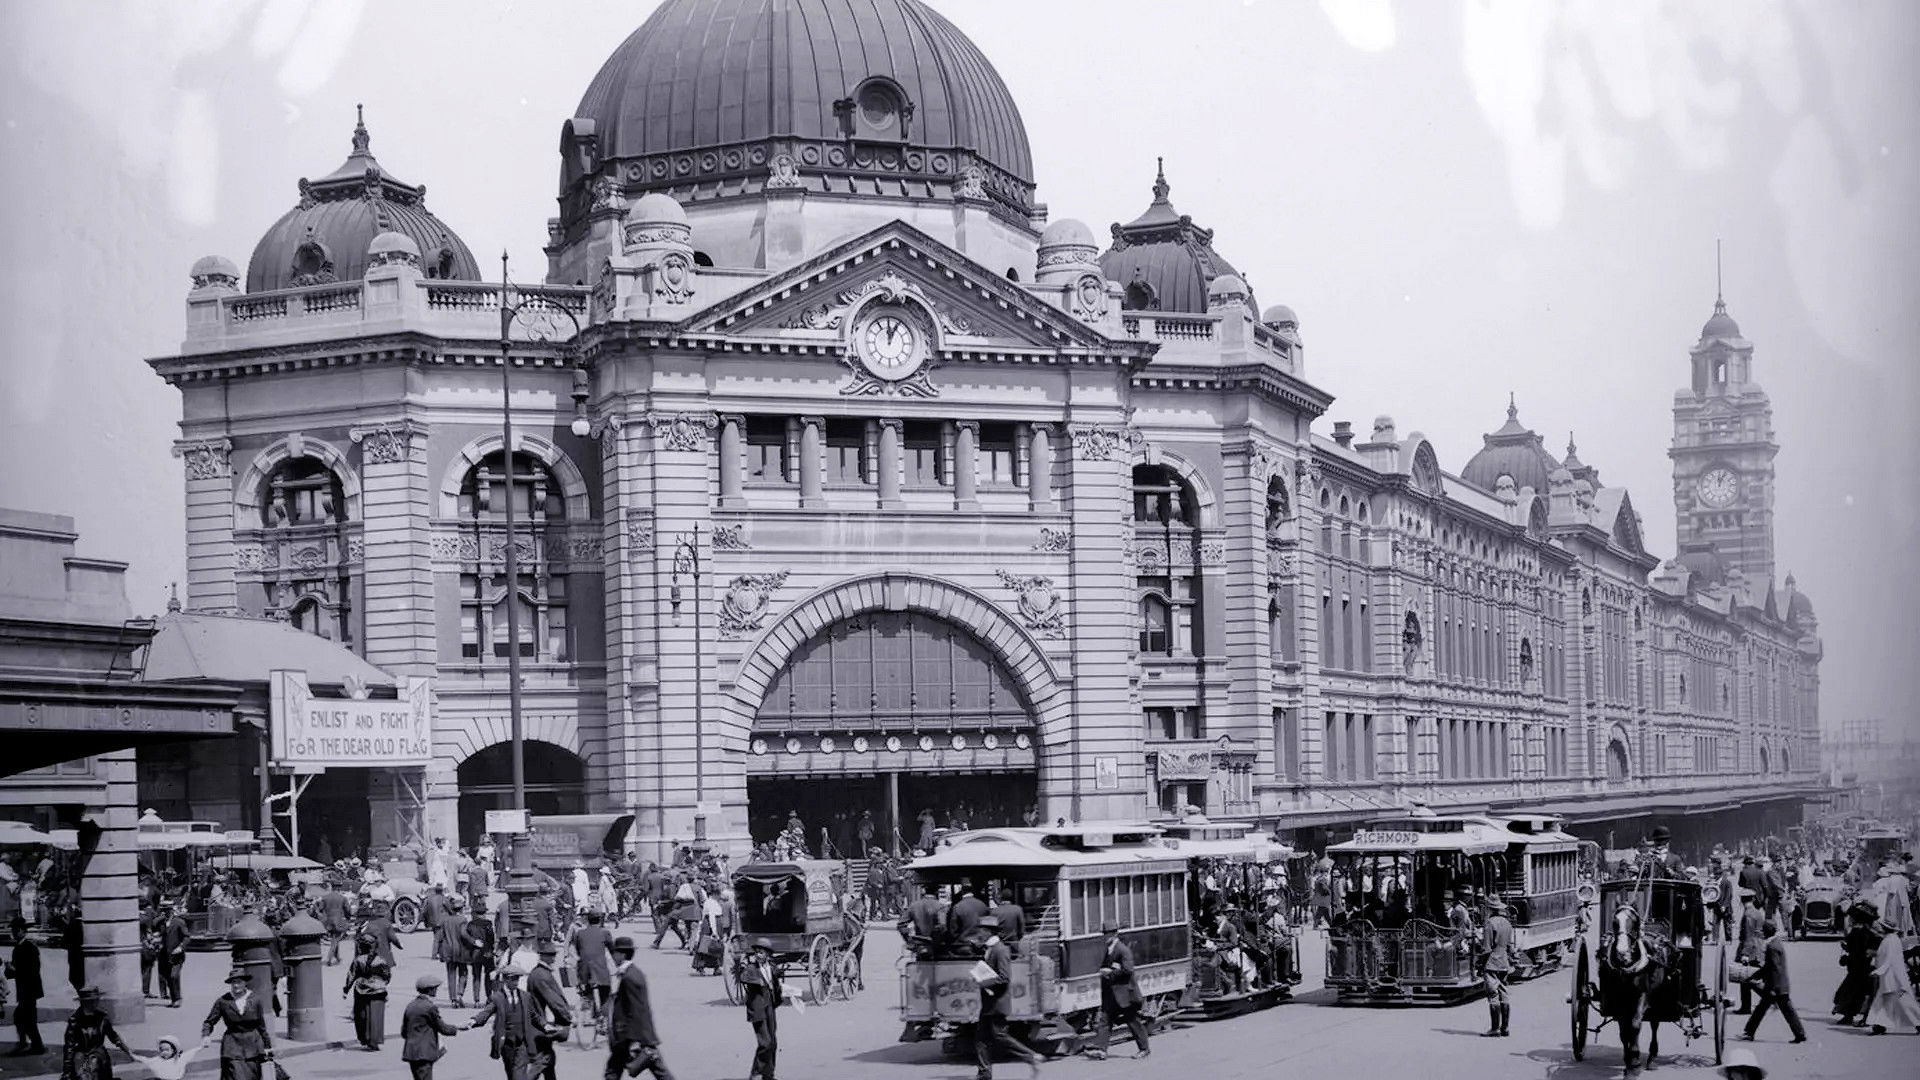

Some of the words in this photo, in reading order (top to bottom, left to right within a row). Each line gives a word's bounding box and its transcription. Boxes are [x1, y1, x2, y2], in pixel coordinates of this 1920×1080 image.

[311, 711, 348, 729] ENLIST
[355, 714, 374, 729] AND
[381, 712, 409, 729] FIGHT
[289, 738, 316, 755] FOR
[320, 738, 344, 755] THE
[344, 738, 371, 755] DEAR
[374, 738, 394, 755] OLD
[400, 738, 428, 755] FLAG
[1354, 832, 1419, 844] RICHMOND
